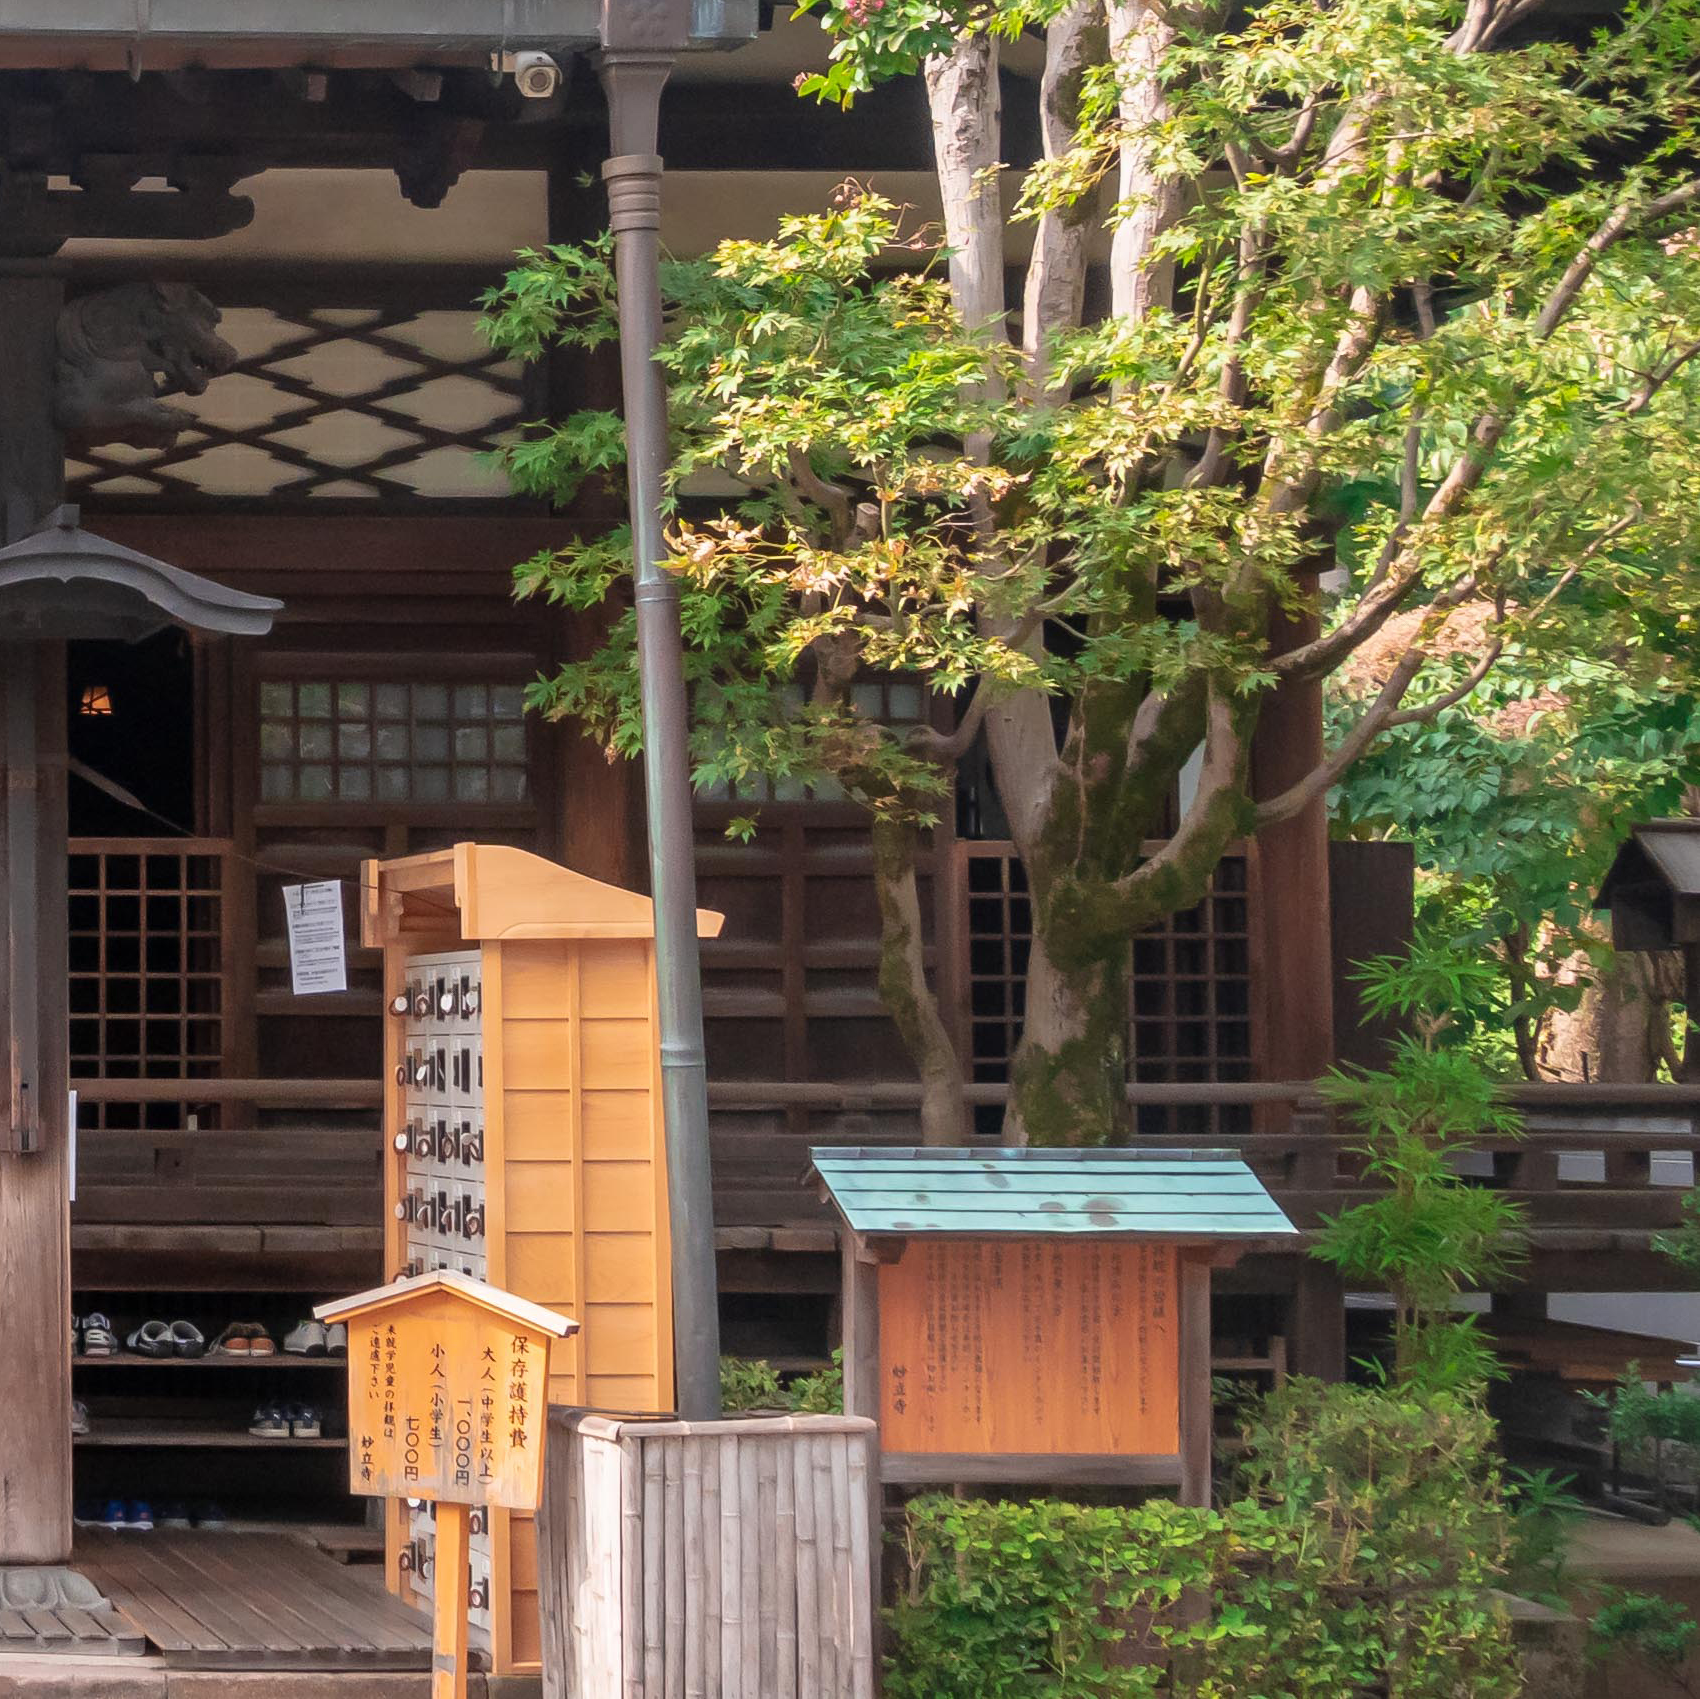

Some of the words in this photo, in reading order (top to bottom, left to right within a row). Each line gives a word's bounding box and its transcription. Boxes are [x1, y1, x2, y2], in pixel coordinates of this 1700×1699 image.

[508, 1334, 530, 1449] 保存護持費
[361, 1435, 375, 1482] 妙立寺
